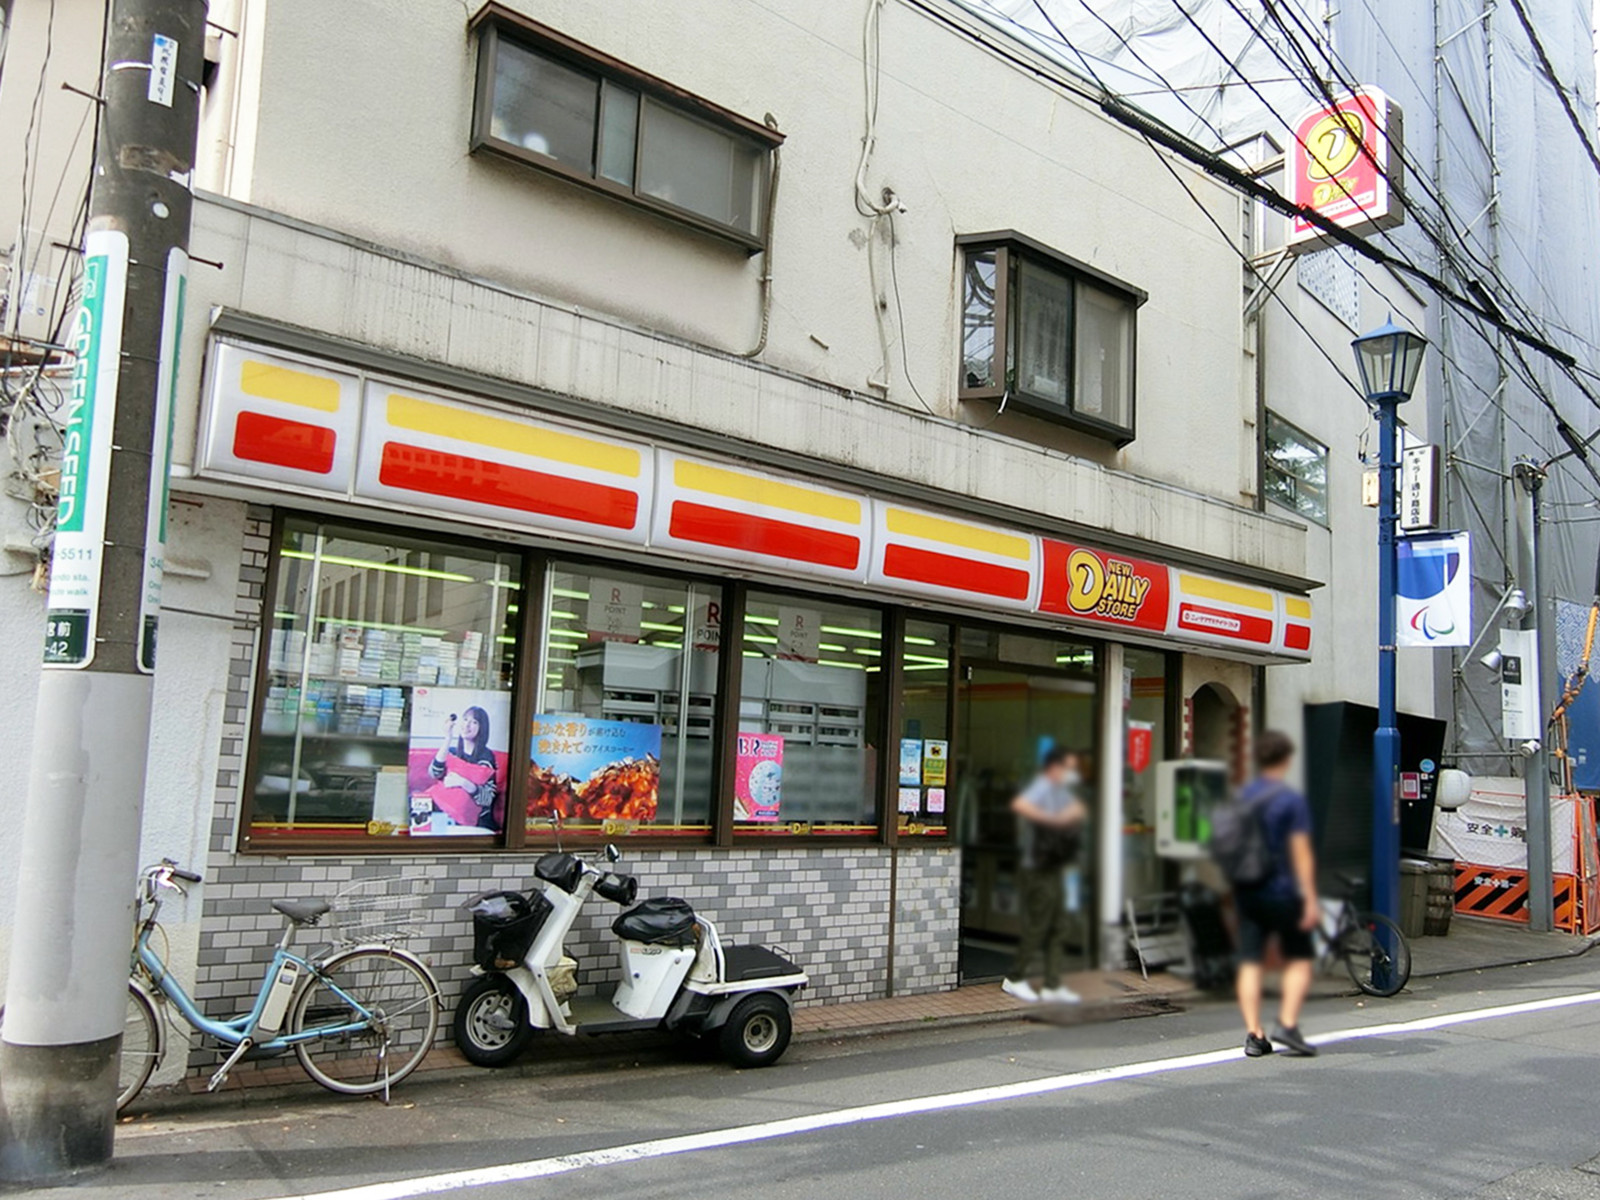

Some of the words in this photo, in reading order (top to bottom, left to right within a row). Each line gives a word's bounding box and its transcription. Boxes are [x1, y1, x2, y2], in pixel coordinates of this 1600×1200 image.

[1107, 562, 1131, 575] NEW
[1068, 549, 1150, 612] DAILY
[611, 588, 621, 602] R
[707, 602, 720, 624] R
[1097, 598, 1137, 618] STORE
[1466, 823, 1493, 836] 安全
